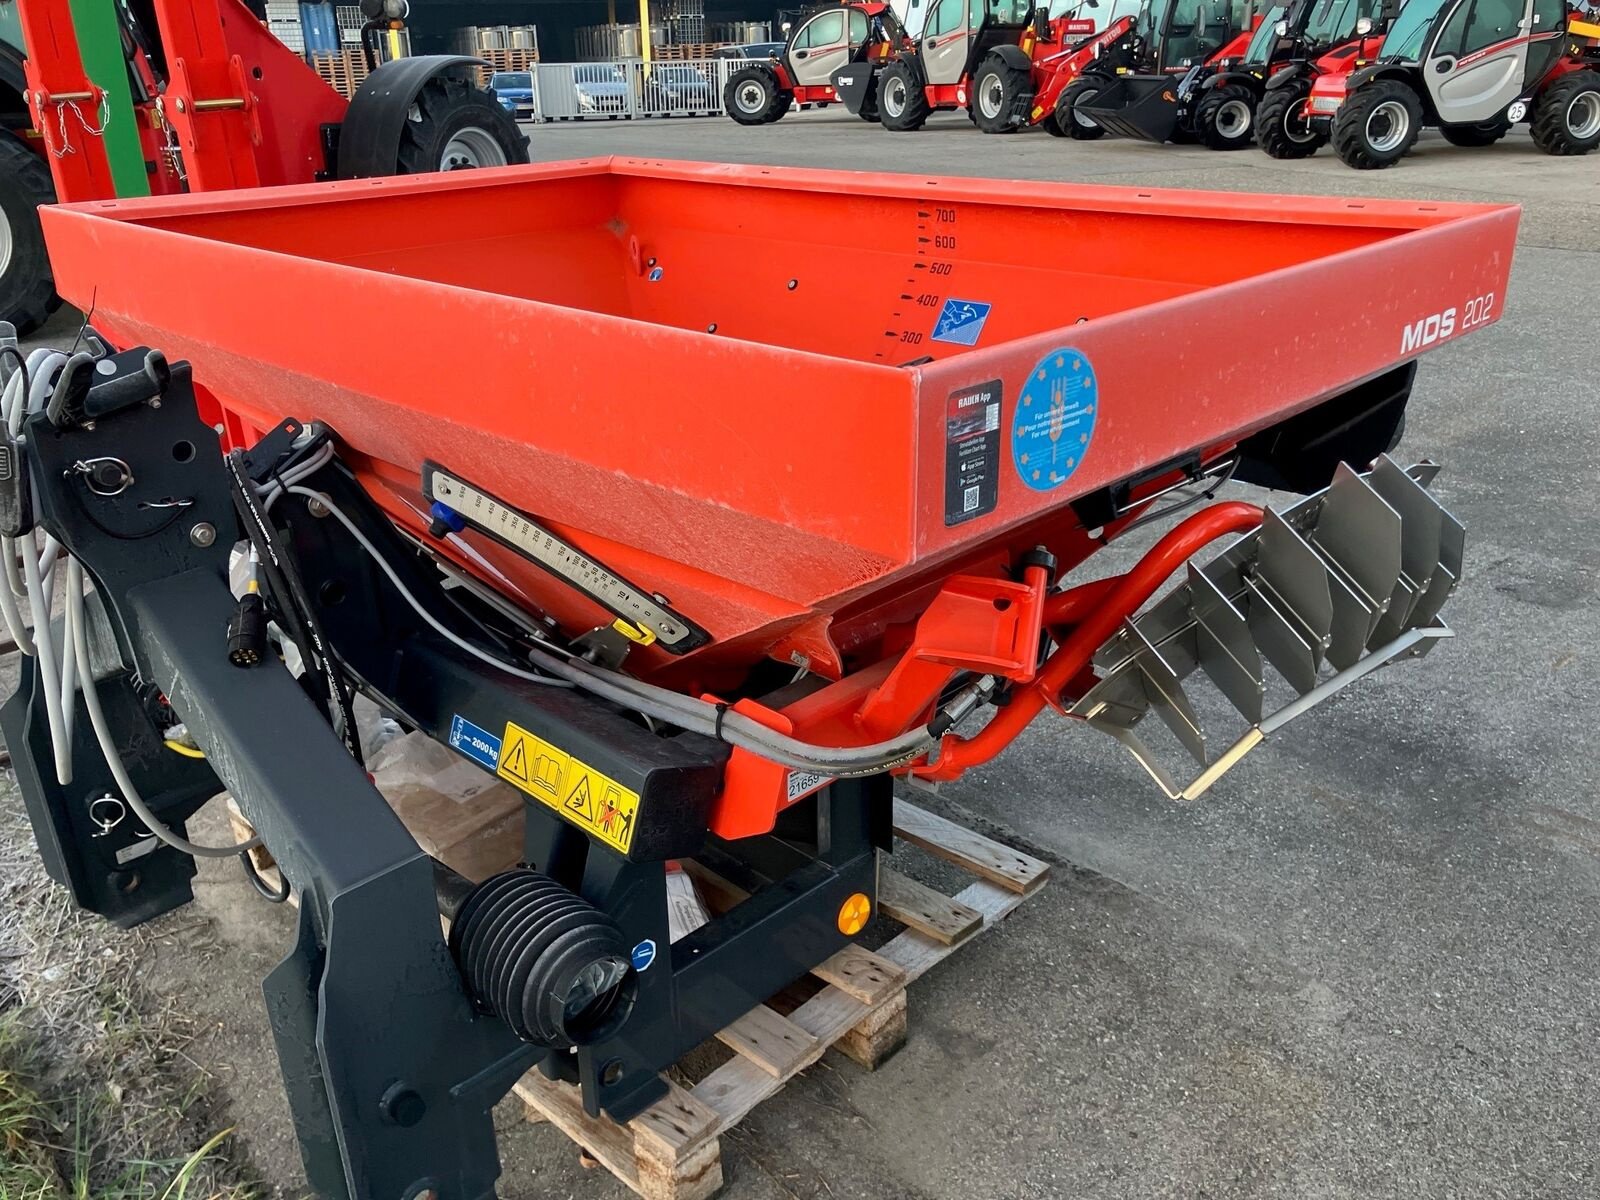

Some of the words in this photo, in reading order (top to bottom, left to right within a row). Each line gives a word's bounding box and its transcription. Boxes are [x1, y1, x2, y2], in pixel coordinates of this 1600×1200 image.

[1510, 106, 1522, 119] 25
[936, 209, 956, 223] 700
[935, 236, 956, 249] 600
[929, 263, 952, 275] 500
[916, 294, 939, 307] 400
[1400, 307, 1457, 355] MDS
[900, 331, 923, 344] 300
[958, 393, 980, 409] RAUCH
[980, 392, 992, 403] App
[1034, 411, 1044, 421] Für
[1024, 423, 1037, 433] Pour
[1037, 419, 1051, 430] notre
[1031, 430, 1040, 440] For
[1040, 428, 1049, 437] our
[967, 462, 975, 471] App
[974, 460, 985, 468] Store
[966, 476, 978, 485] Google
[977, 473, 985, 482] Play
[488, 503, 496, 515] 450
[501, 511, 509, 523] 400
[511, 517, 519, 529] 350
[521, 523, 530, 536] 300
[532, 530, 541, 542] 250
[544, 538, 553, 550] 200
[558, 546, 567, 556] 150
[572, 555, 581, 566] 100
[580, 560, 588, 569] 80
[591, 567, 599, 576] 50
[600, 573, 608, 582] 30
[617, 590, 626, 599] 10
[471, 737, 490, 754] 2000
[489, 746, 498, 761] kg
[789, 774, 819, 797] 21659
